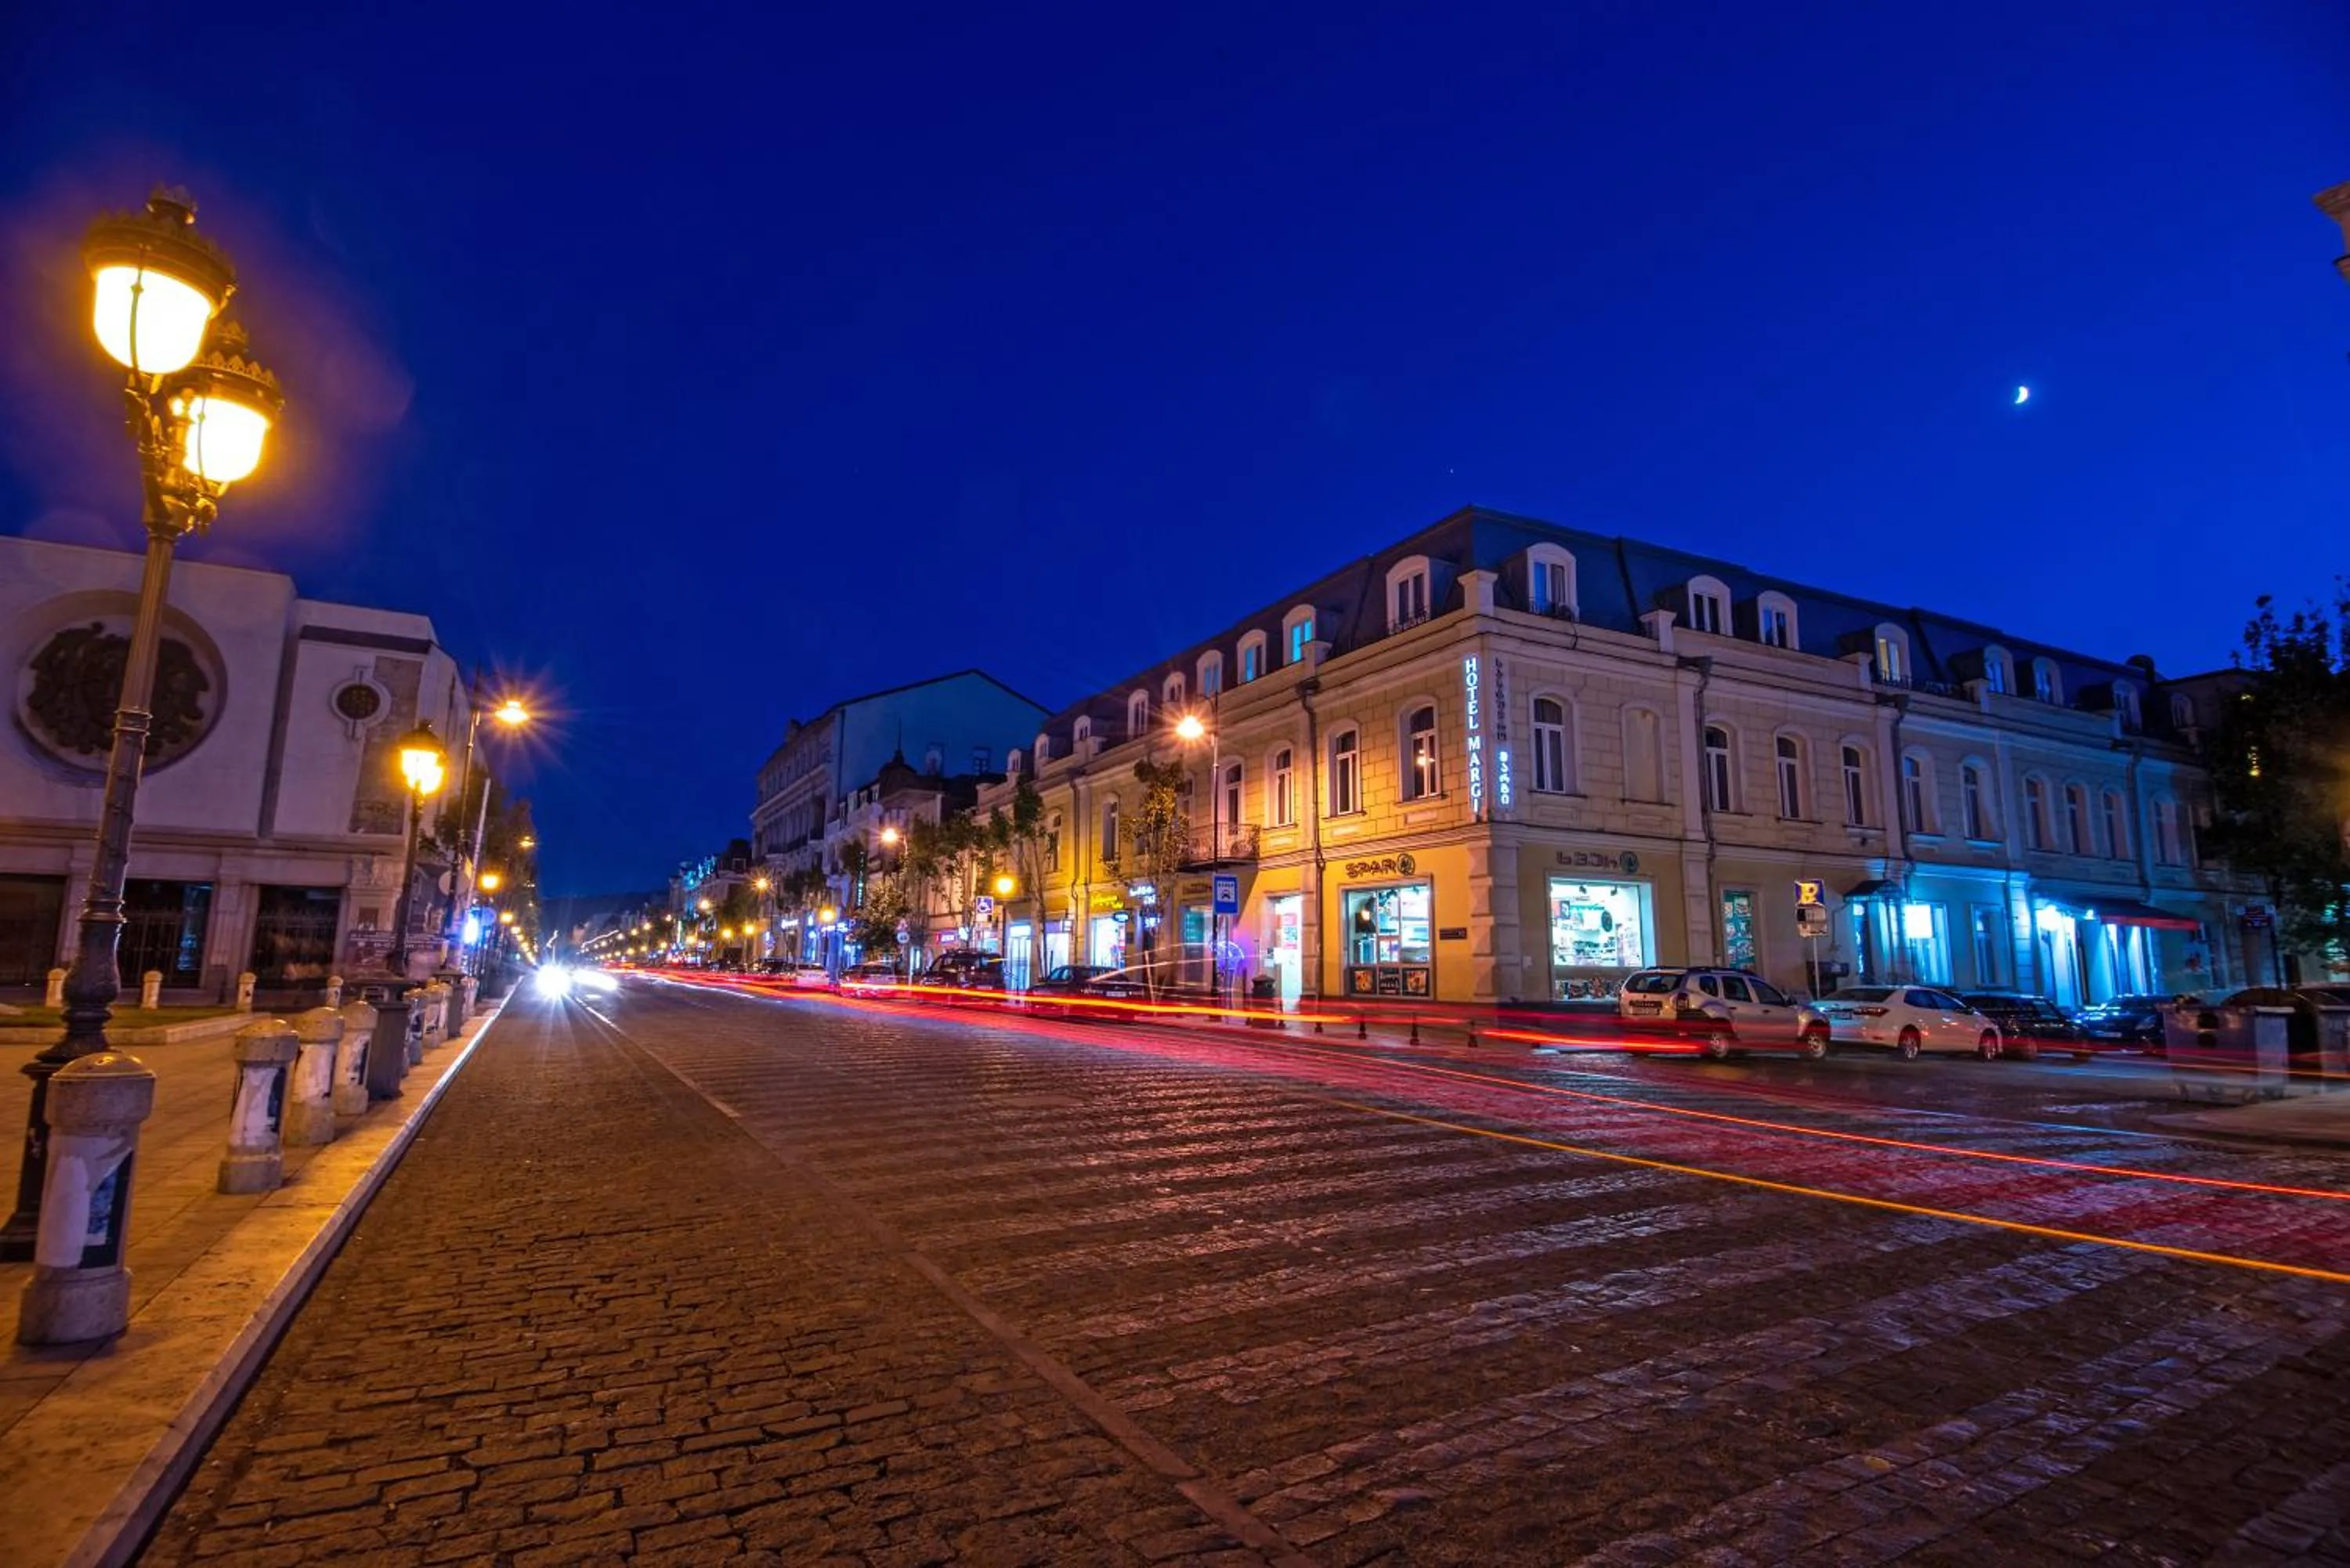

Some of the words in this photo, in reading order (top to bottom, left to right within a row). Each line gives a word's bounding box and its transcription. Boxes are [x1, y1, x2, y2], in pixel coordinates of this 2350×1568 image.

[1465, 657, 1479, 729] HOTEL
[1468, 735, 1481, 812] MARGI
[1345, 858, 1397, 878] SPAR
